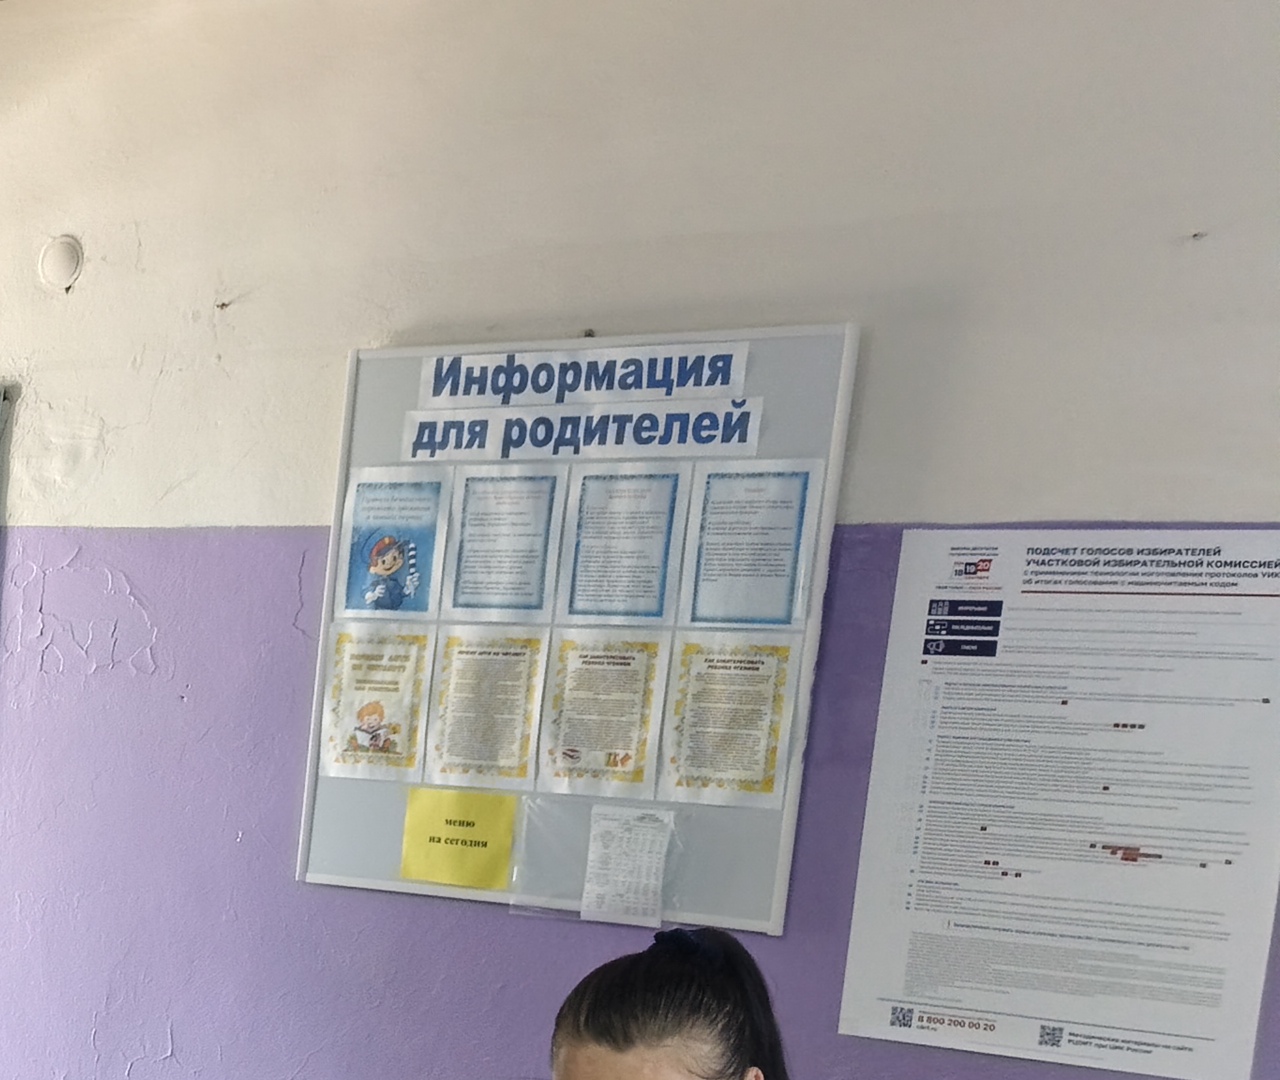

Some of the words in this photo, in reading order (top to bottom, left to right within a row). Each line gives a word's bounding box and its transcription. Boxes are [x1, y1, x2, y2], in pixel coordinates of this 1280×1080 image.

[432, 352, 732, 403] Информация
[412, 416, 488, 457] для
[501, 400, 750, 458] родителей
[1026, 547, 1078, 556] ПОДСЧЕТ
[1080, 548, 1134, 556] ГОЛОСОВ
[1136, 546, 1222, 556] ИЗБИРАТЕЛЕЙ
[977, 561, 990, 570] 20
[1025, 558, 1100, 567] УЧАСТКОВОЙ
[1103, 558, 1204, 568] ИЗБИРАТЕЛЬНОЙ
[445, 818, 475, 829] меню
[428, 835, 441, 844] на
[444, 837, 488, 849] сегодня
[926, 1016, 945, 1026] 800
[947, 1019, 965, 1028] 200
[968, 1021, 980, 1030] 00
[983, 1023, 996, 1032] 20
